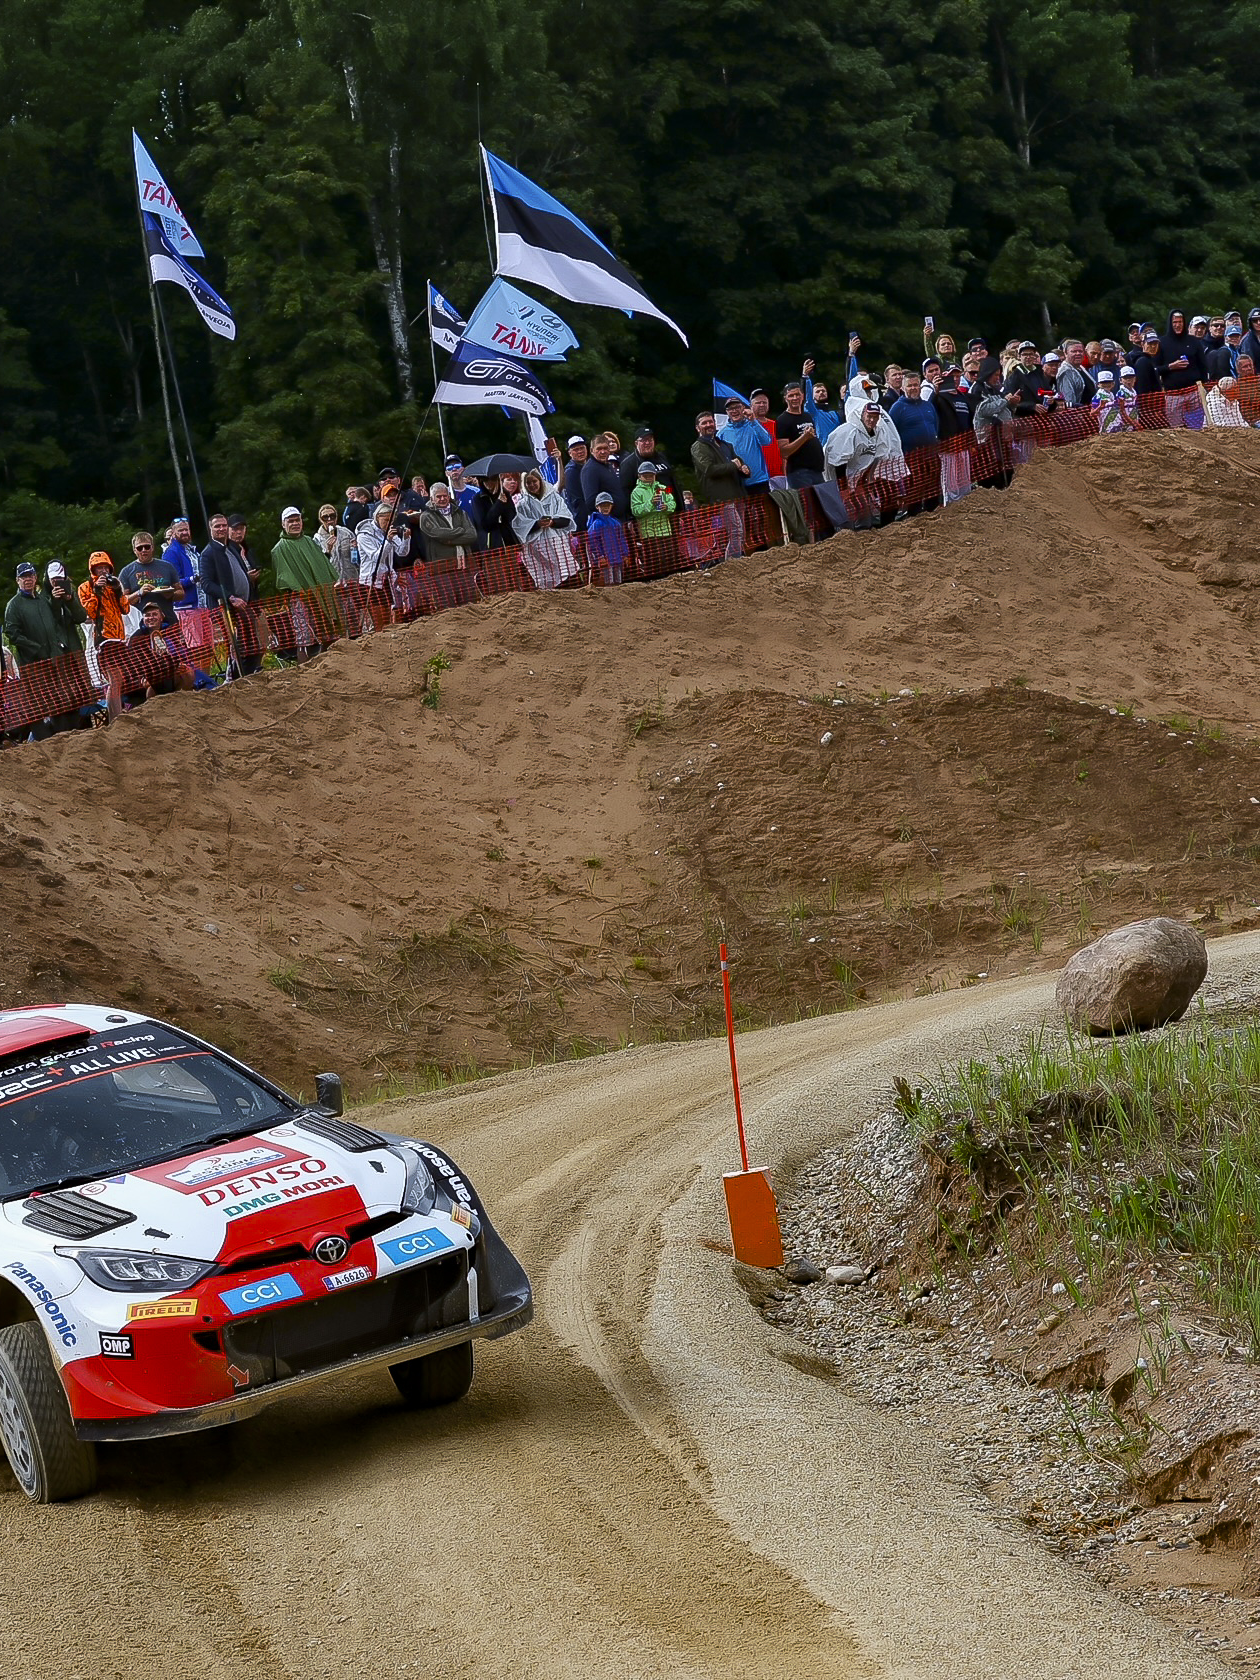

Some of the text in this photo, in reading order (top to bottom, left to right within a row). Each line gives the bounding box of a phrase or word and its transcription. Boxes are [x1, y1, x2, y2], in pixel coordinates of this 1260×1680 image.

[39, 1045, 99, 1065] GAZOO
[100, 1034, 156, 1049] Racing
[69, 1059, 111, 1076] ALL
[107, 1047, 157, 1065] LIVE
[198, 1159, 327, 1206] DENSO
[223, 1175, 345, 1217] DMG MORI
[2, 1261, 77, 1348] Panasonic
[130, 1301, 192, 1317] PIRELLI
[102, 1338, 131, 1354] OMP
